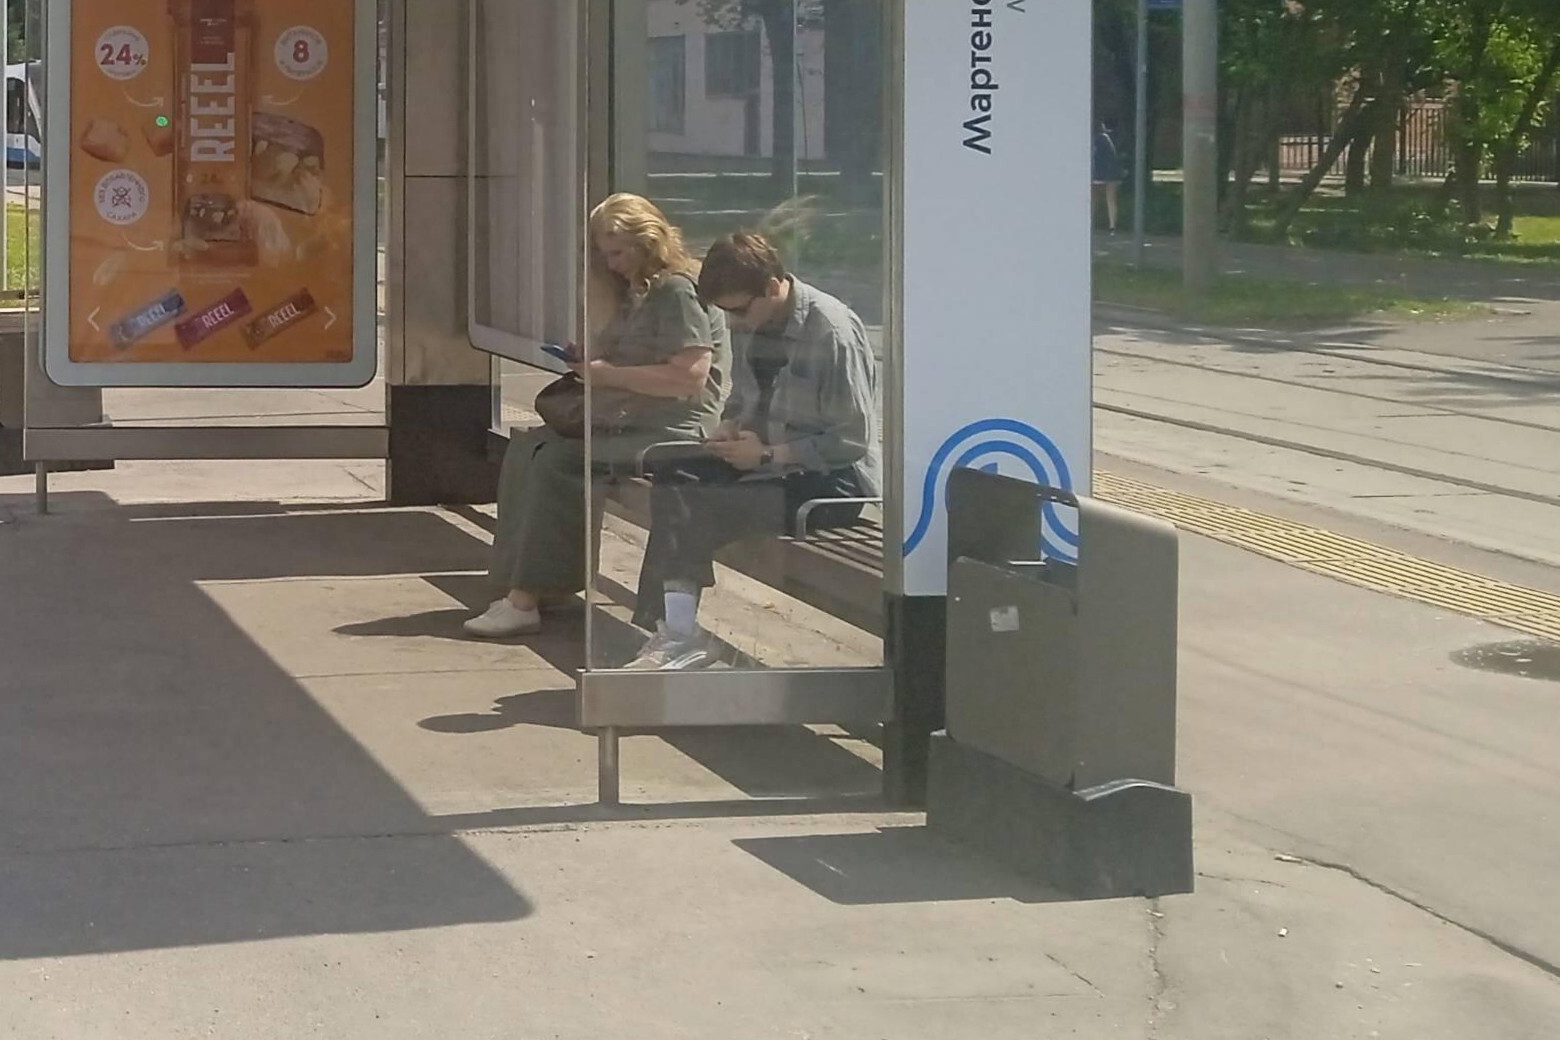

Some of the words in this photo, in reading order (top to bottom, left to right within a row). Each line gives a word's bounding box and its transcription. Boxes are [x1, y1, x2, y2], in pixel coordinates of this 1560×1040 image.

[100, 43, 147, 65] 24%
[293, 40, 309, 63] 8
[190, 52, 235, 162] REEEL
[201, 302, 235, 328] REEEL
[267, 302, 301, 328] REEEL
